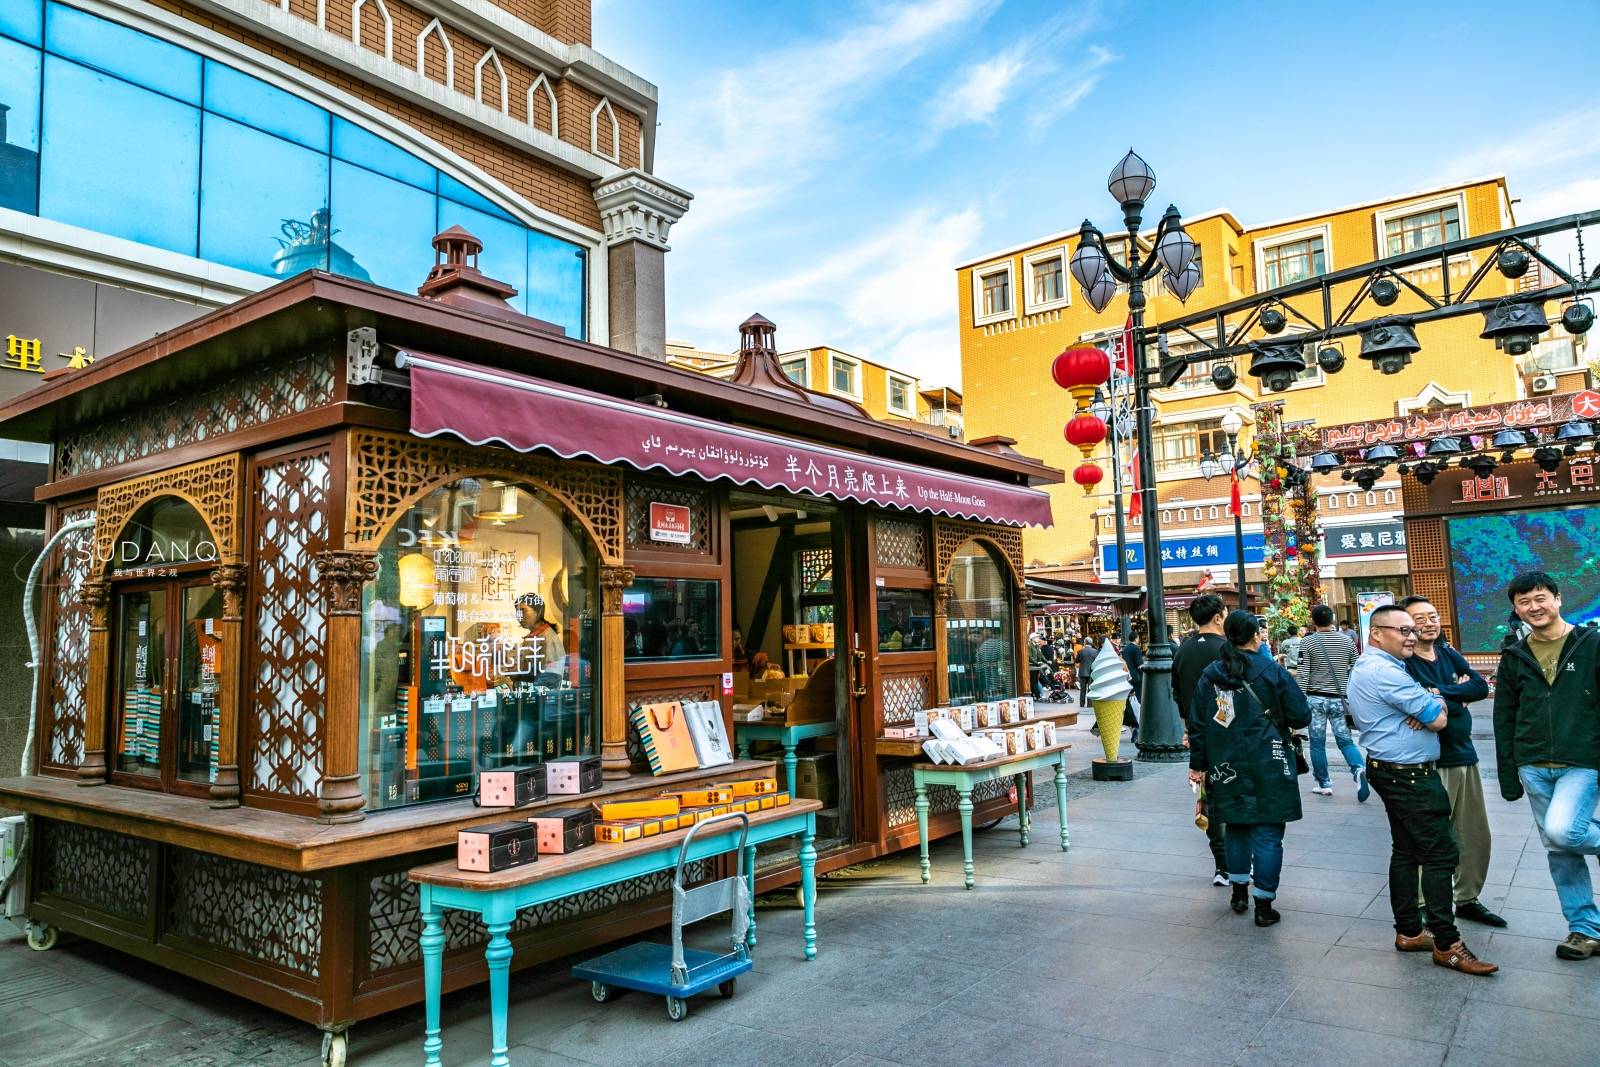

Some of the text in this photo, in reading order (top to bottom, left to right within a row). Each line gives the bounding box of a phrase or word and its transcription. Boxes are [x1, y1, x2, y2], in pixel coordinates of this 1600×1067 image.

[785, 454, 910, 498] 半个月亮爬上来
[917, 485, 986, 507] Up the Half-Moon Goes
